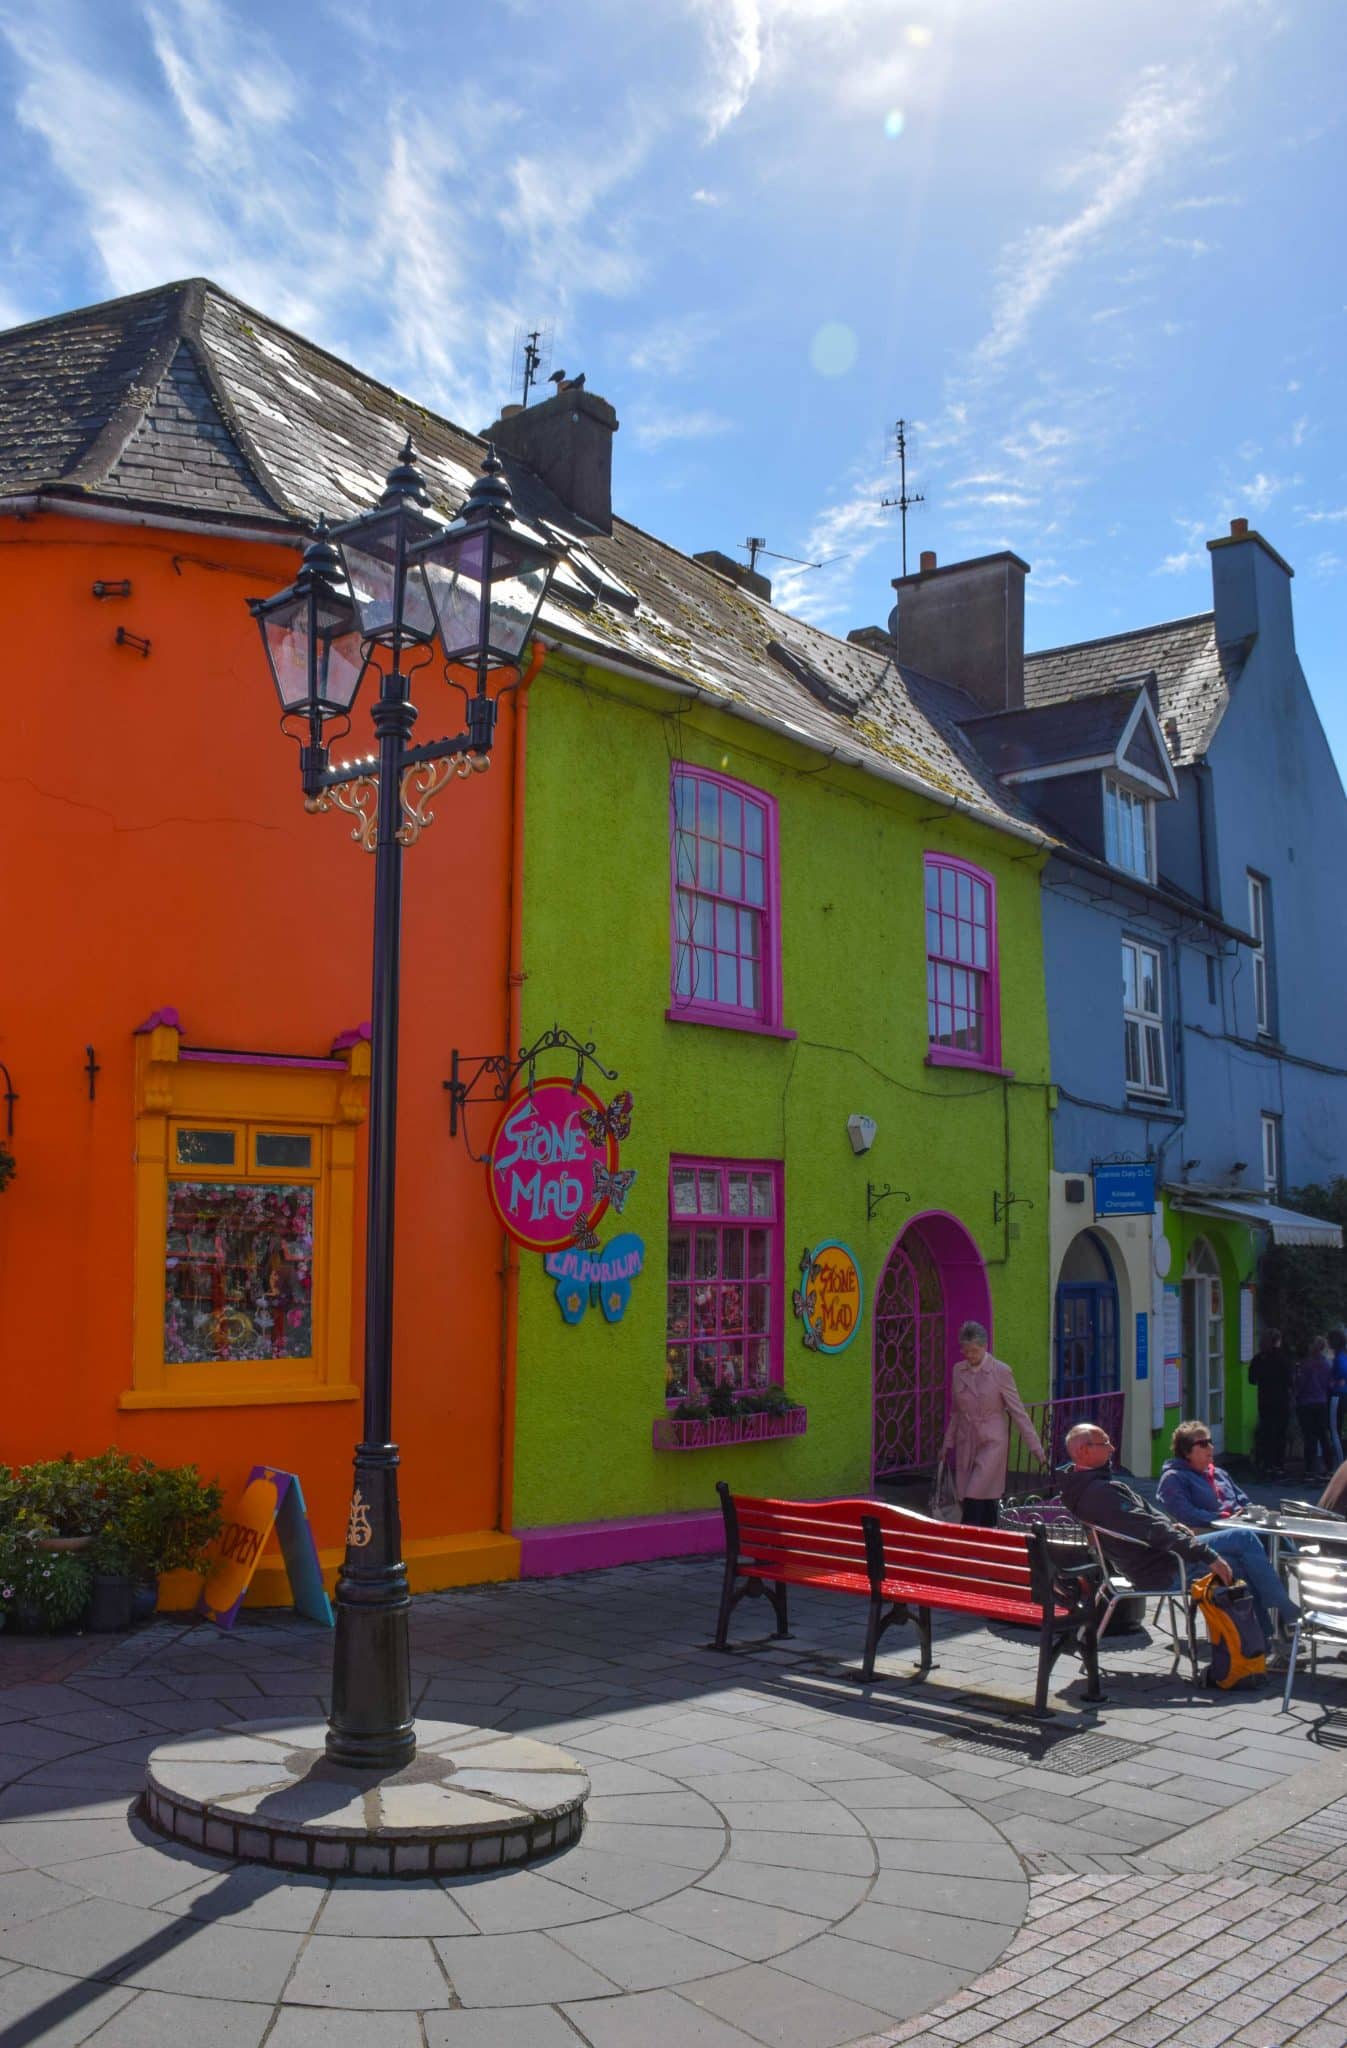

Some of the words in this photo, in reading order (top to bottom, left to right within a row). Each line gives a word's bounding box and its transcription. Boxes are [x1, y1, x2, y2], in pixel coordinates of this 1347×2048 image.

[495, 1102, 586, 1181] STONE
[509, 1171, 584, 1221] MAD
[546, 1249, 643, 1282] EMPORIUM
[820, 1264, 855, 1300] STONE
[821, 1297, 852, 1332] MAD
[221, 1522, 264, 1568] OPEN
